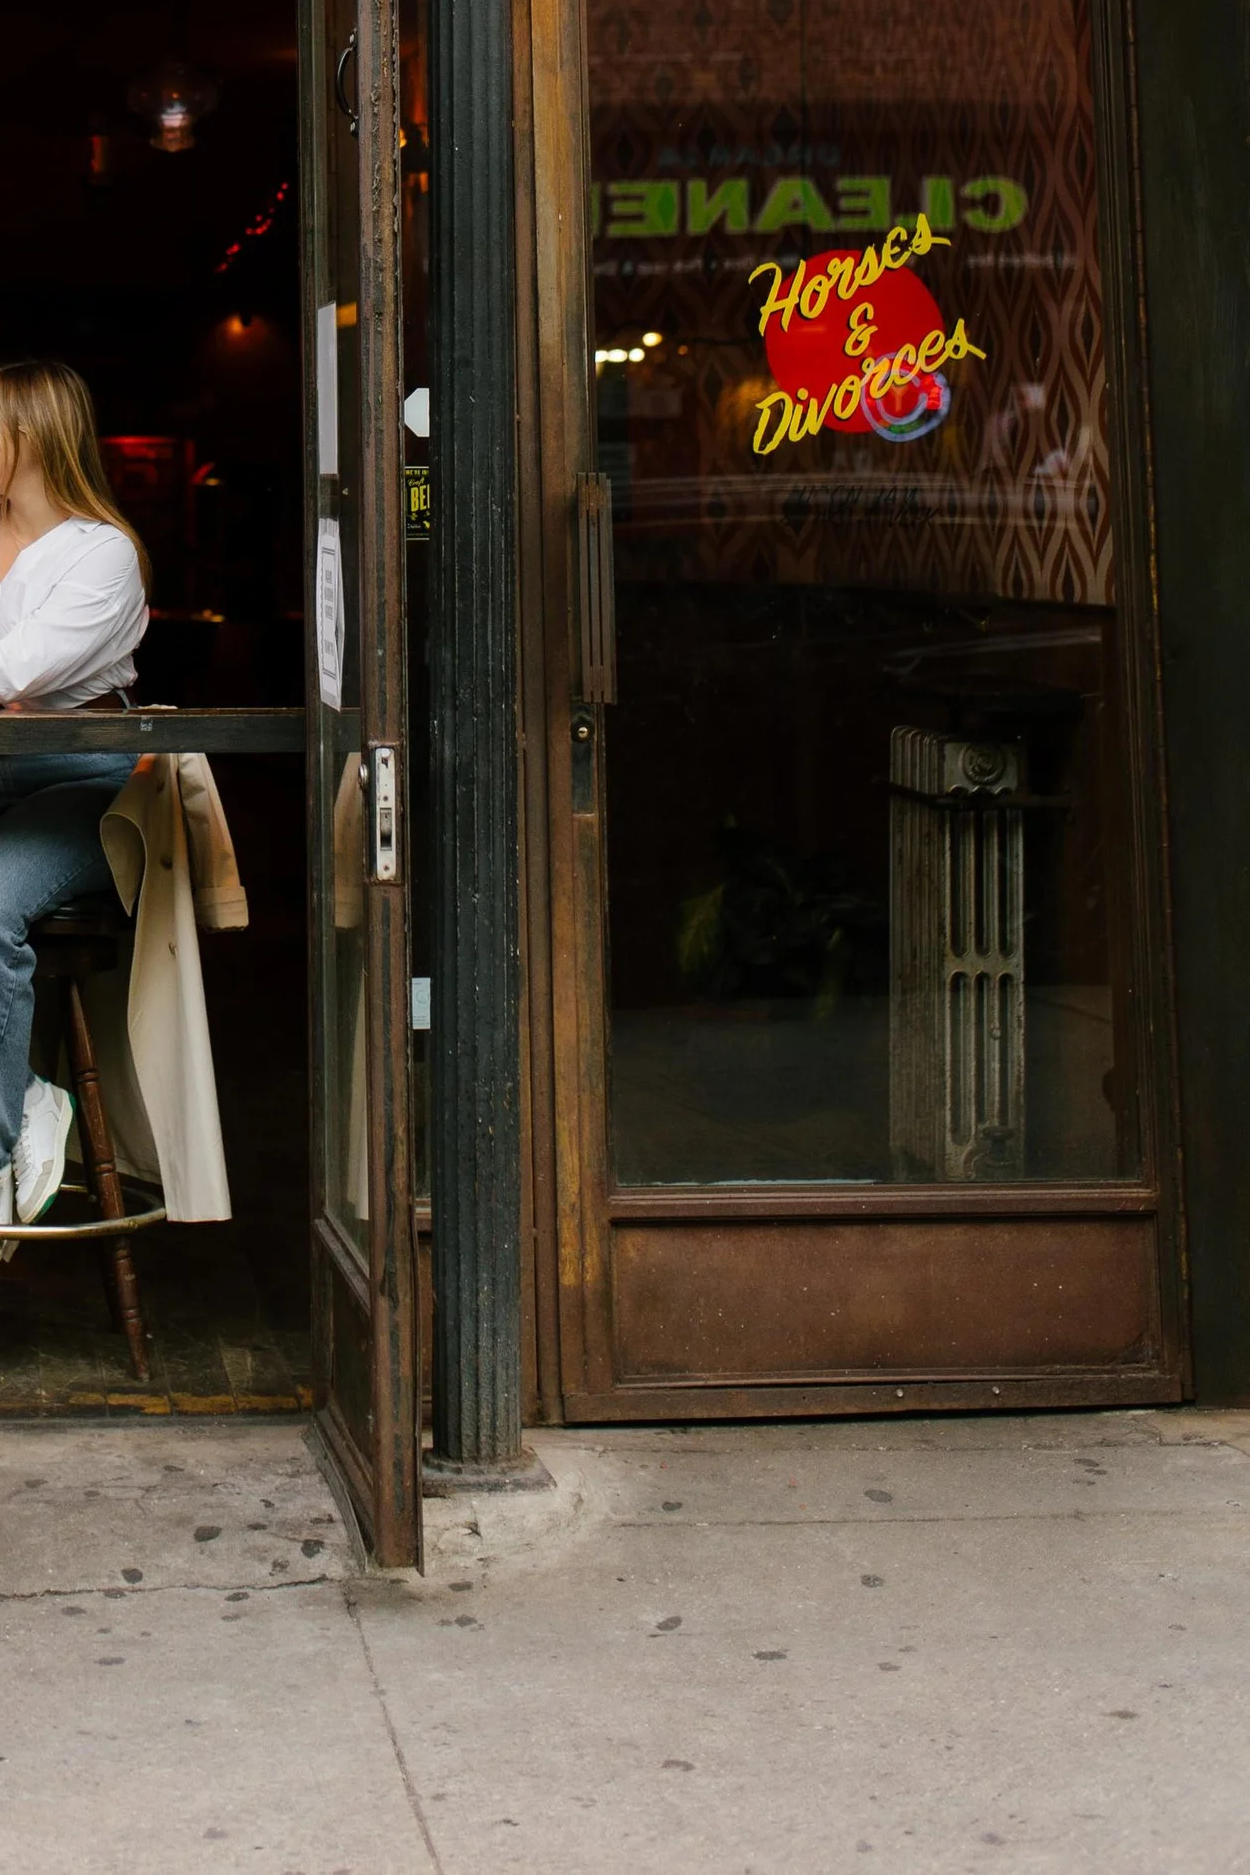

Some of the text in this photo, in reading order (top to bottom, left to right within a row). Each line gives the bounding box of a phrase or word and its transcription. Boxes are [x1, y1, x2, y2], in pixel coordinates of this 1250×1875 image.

[748, 213, 951, 337] Horses
[845, 302, 878, 357] &
[753, 318, 987, 456] Divorces
